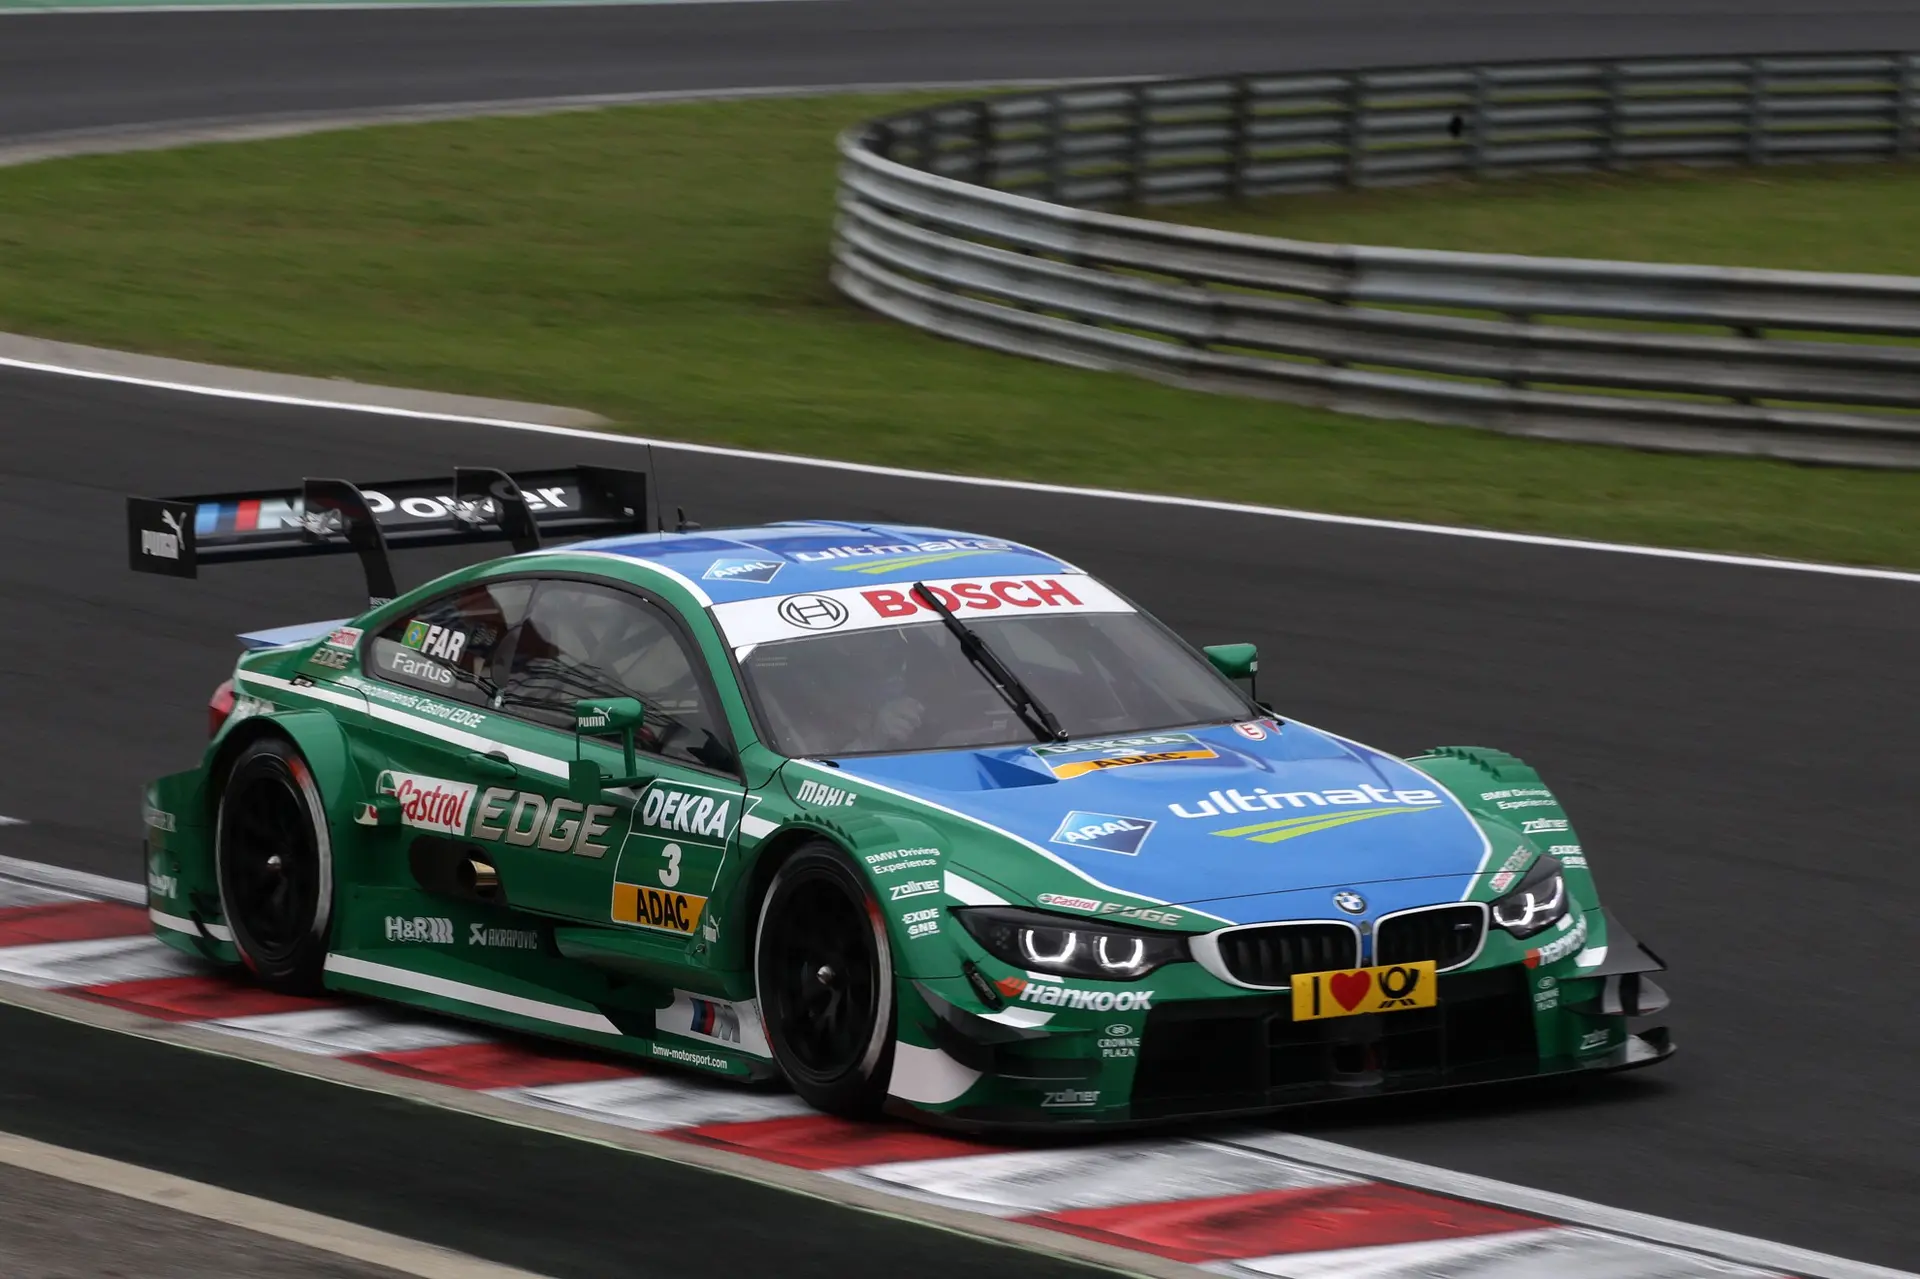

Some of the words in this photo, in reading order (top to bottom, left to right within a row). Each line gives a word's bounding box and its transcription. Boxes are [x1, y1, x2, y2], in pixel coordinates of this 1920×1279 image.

[796, 539, 1012, 562] ultimate
[713, 561, 777, 578] ARAL
[860, 579, 1084, 618] BOSCH
[421, 624, 466, 662] FAR
[392, 652, 452, 683] Farfus
[416, 698, 455, 719] Castrol
[449, 708, 486, 729] EDGE
[578, 716, 606, 728] PUMA
[1046, 734, 1187, 754] DEKRA
[1091, 751, 1188, 769] ADAC
[643, 787, 731, 838] DEKRA
[1167, 783, 1443, 819] ultimate
[397, 779, 469, 828] Castrol
[471, 786, 618, 858] EDGE
[1064, 819, 1145, 842] ARAL
[658, 842, 683, 888] 3
[865, 852, 897, 864] BMW
[898, 847, 941, 857] Driving
[872, 858, 937, 874] Experience
[636, 888, 690, 932] ADAC
[901, 908, 940, 924] EXIDE
[1050, 896, 1097, 911] Castrol
[1101, 903, 1182, 926] EDGE
[1312, 975, 1320, 1016] I
[652, 1042, 728, 1069] bmw-motorsport.com
[1097, 1038, 1140, 1048] CROWNE
[1102, 1049, 1135, 1058] PLAZA
